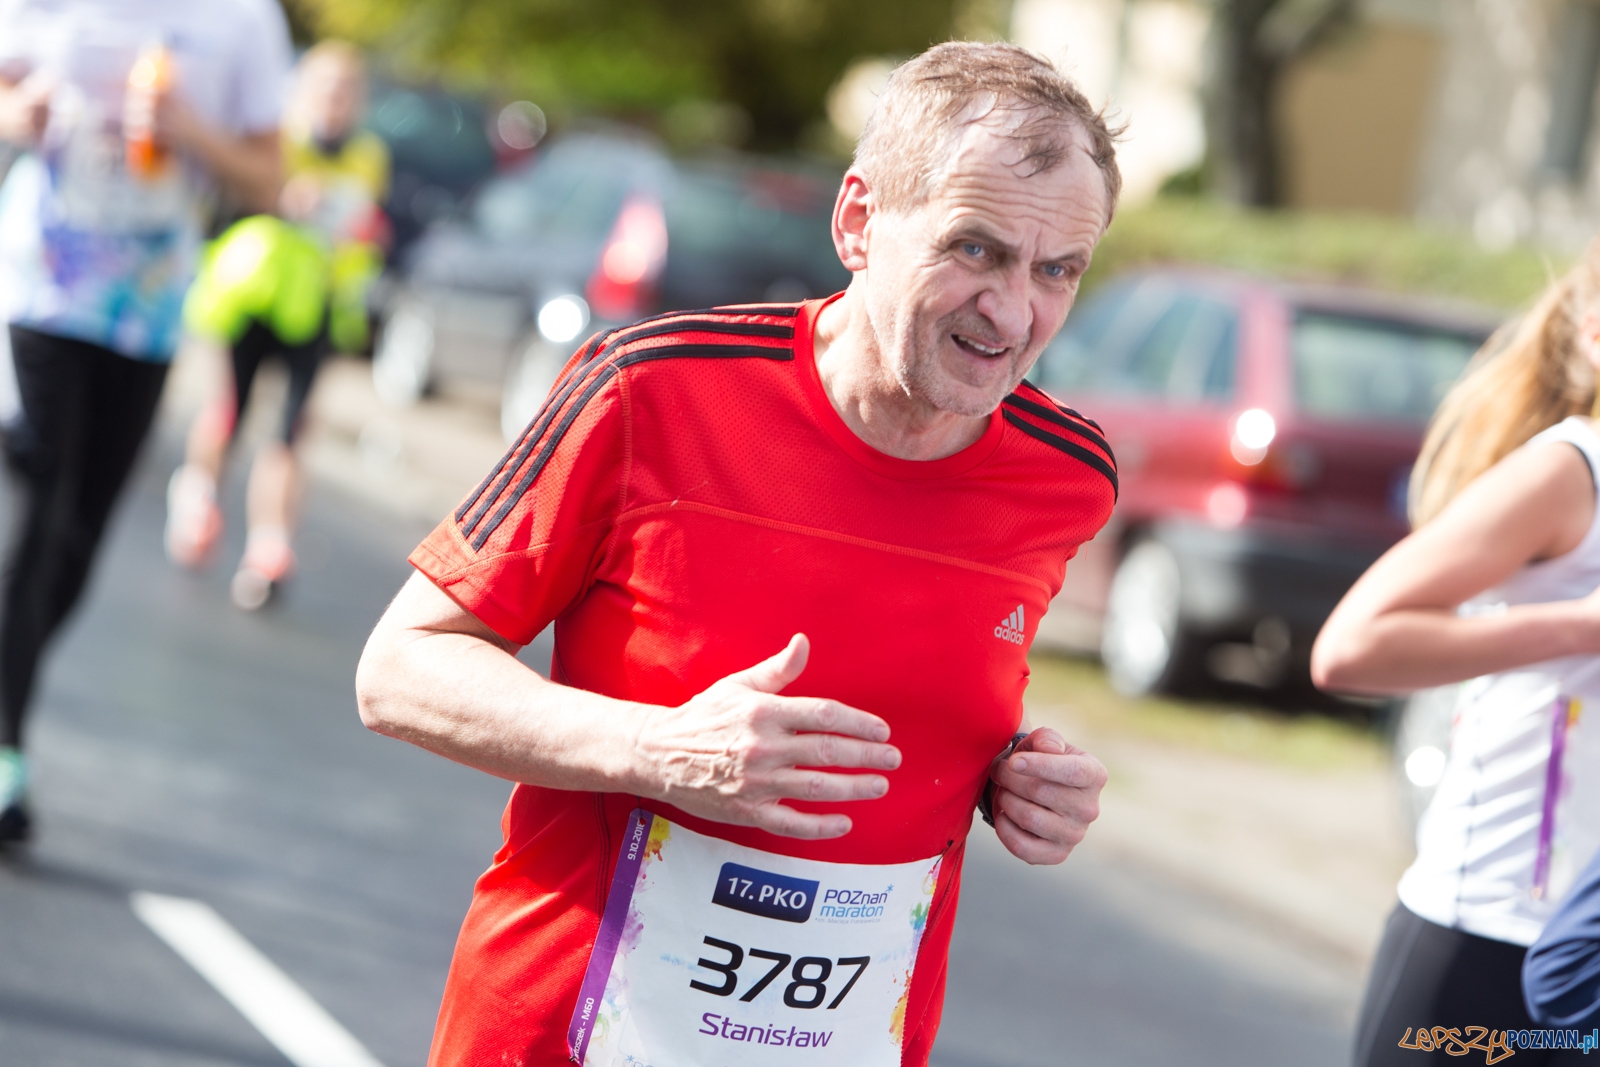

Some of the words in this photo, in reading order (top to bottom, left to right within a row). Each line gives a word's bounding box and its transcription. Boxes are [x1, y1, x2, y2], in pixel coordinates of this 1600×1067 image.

[993, 625, 1025, 646] adidas
[728, 877, 754, 900] 17.
[758, 885, 807, 909] PKO
[819, 904, 885, 918] maraton
[689, 935, 871, 1010] 3787
[581, 997, 595, 1020] M60
[698, 1012, 834, 1048] Stanisław
